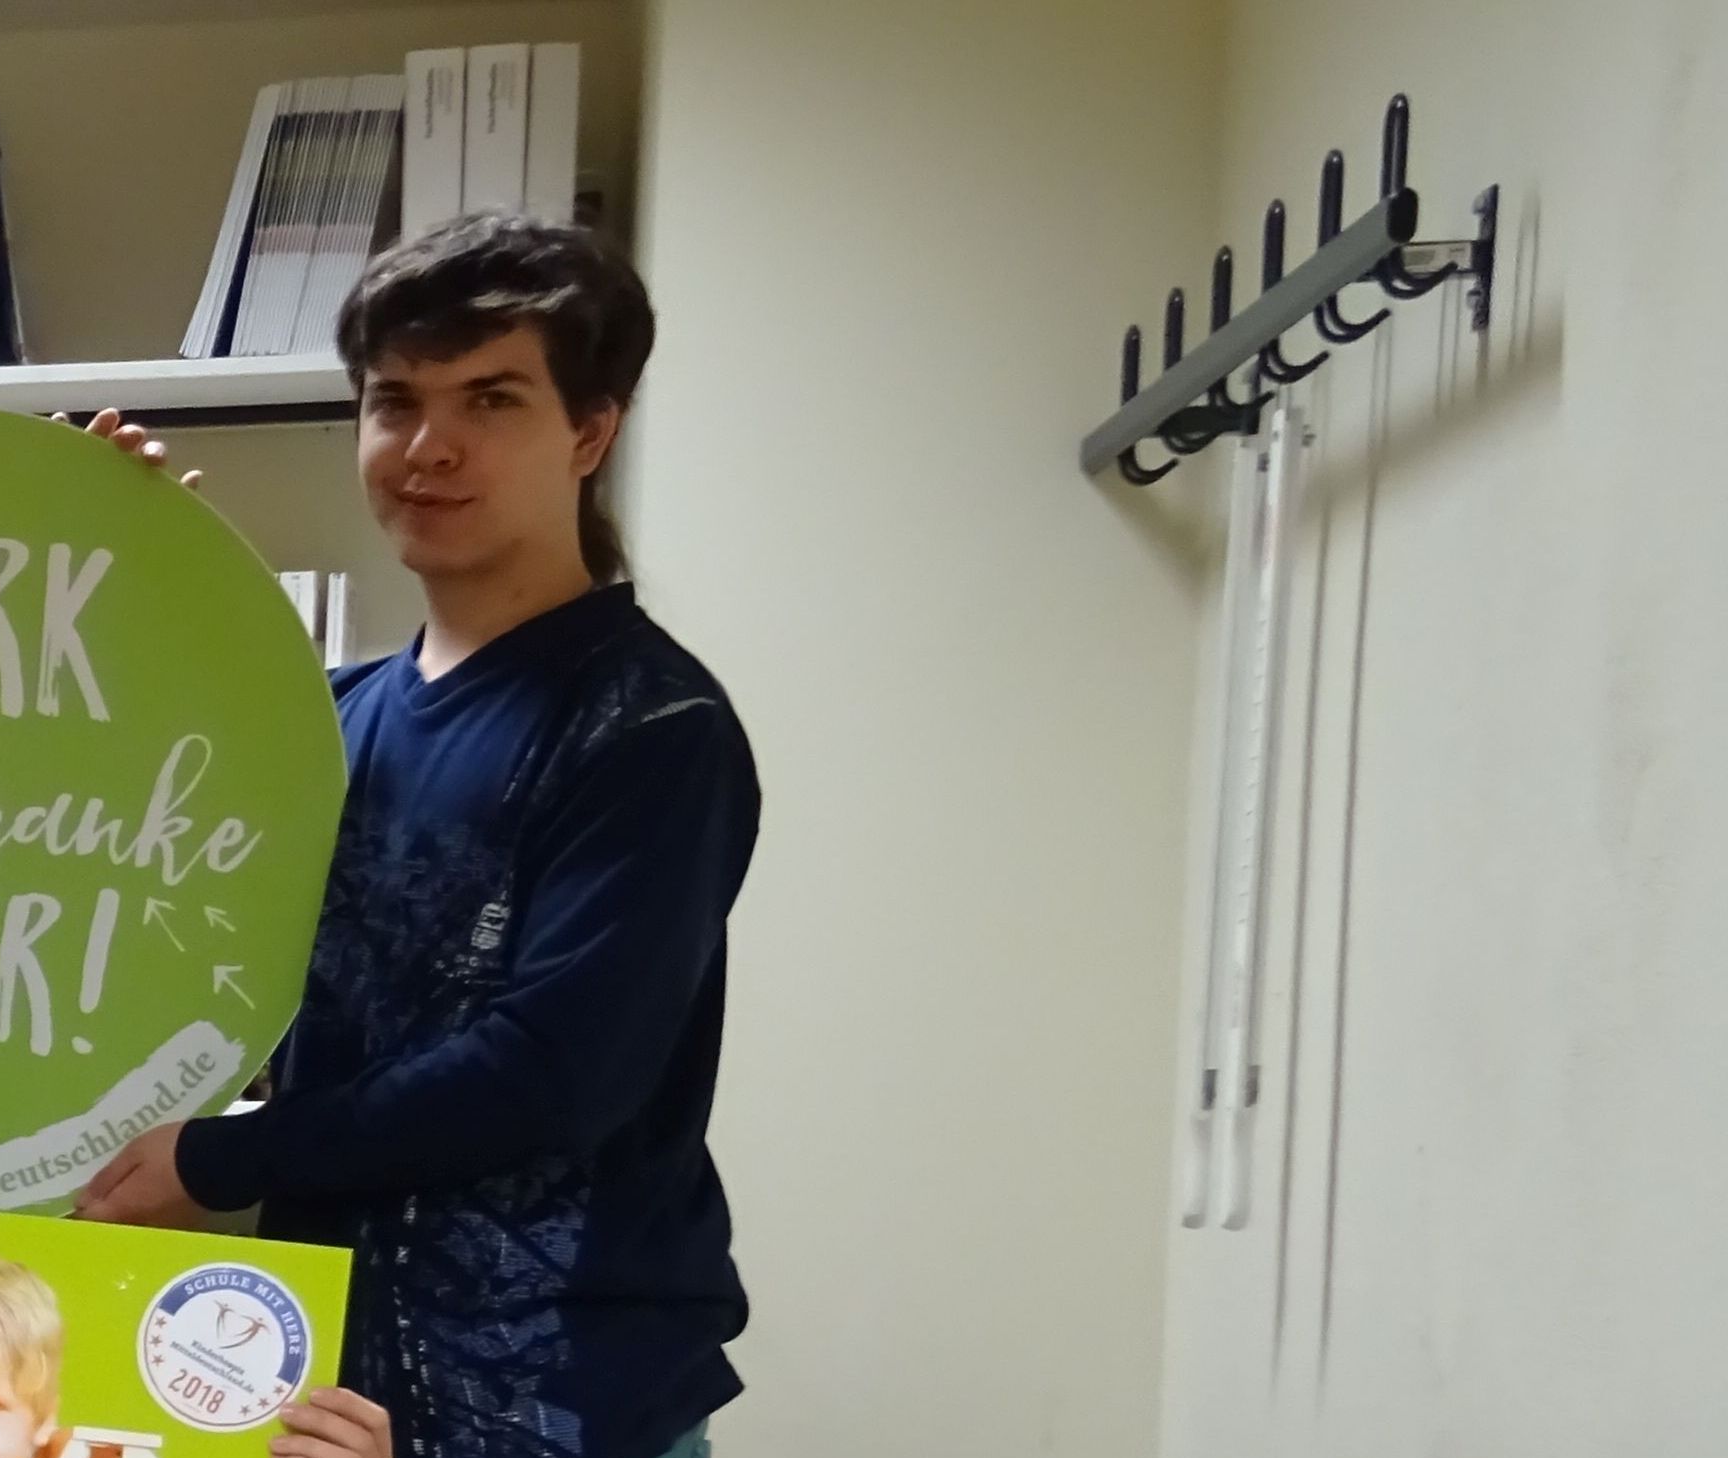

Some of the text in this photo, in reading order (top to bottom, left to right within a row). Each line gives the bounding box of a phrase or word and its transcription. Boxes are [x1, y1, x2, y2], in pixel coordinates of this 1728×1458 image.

[184, 1274, 302, 1355] SCHULE MIT HERZ
[168, 1368, 227, 1415] 2018
